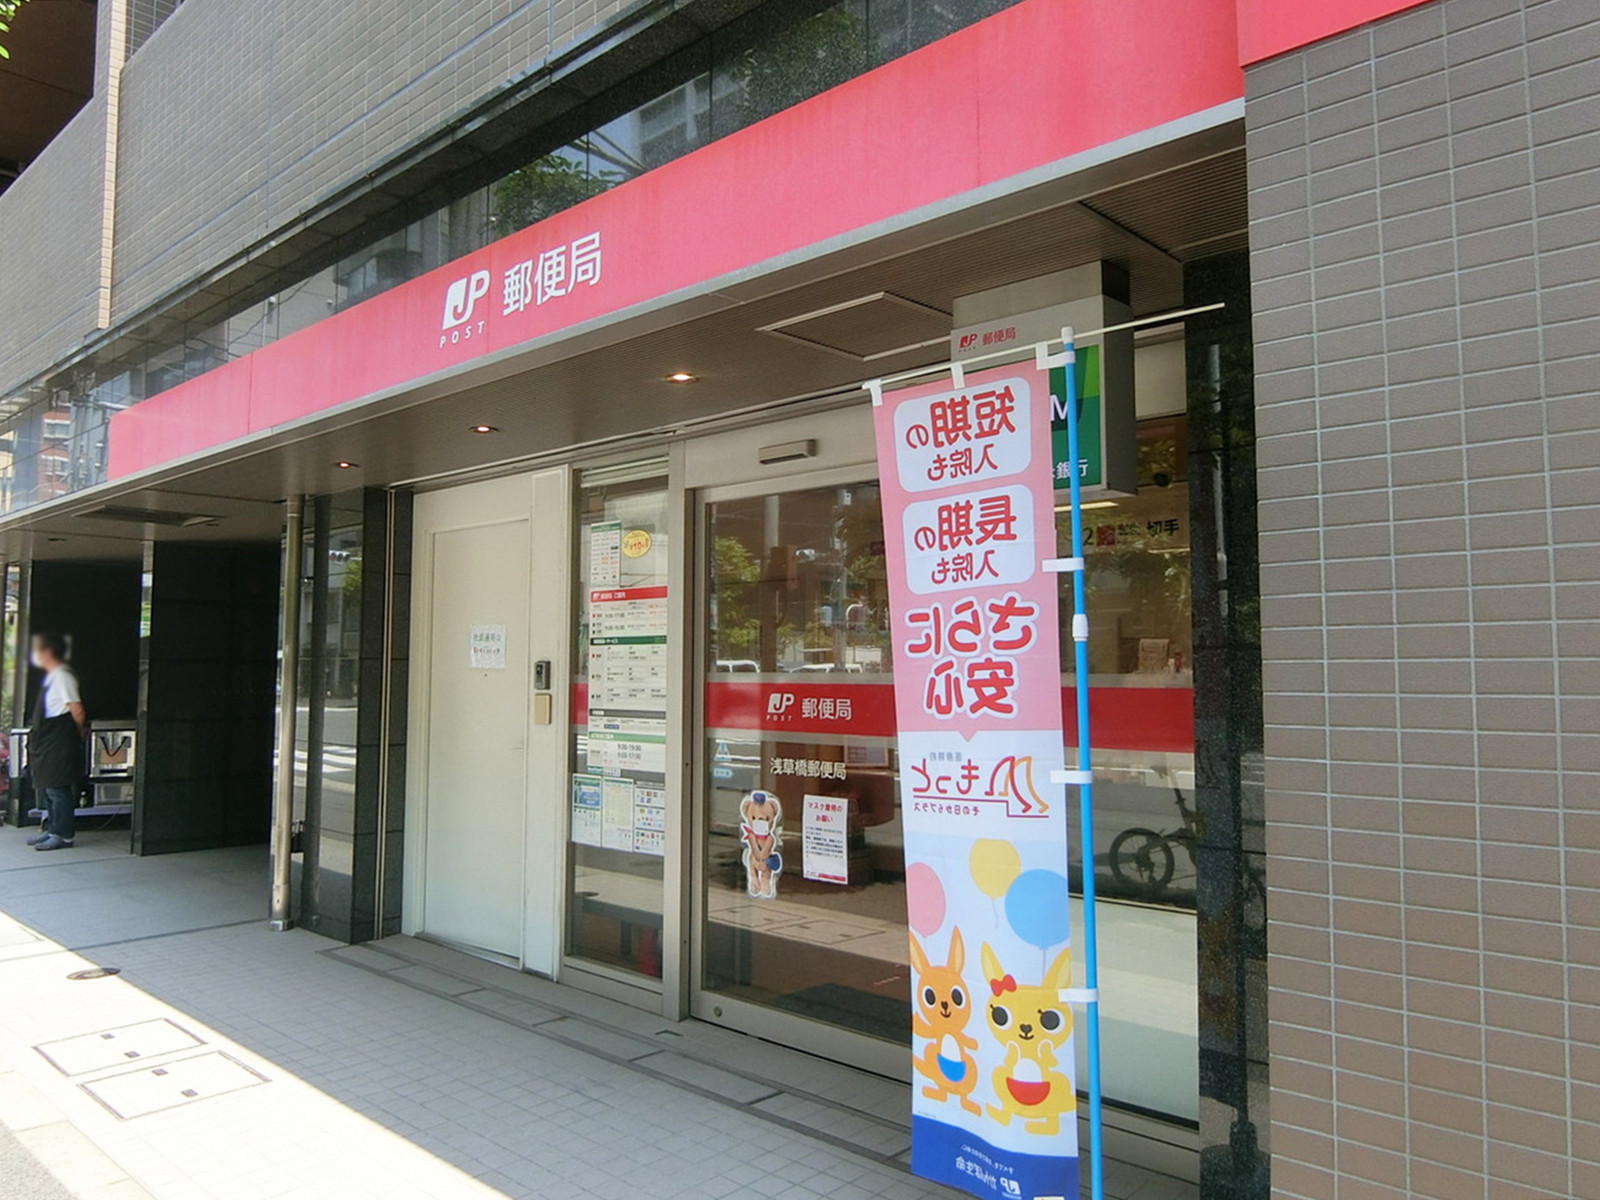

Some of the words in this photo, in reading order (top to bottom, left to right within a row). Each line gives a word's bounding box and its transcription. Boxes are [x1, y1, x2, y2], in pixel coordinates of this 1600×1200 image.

[442, 269, 491, 330] JP
[503, 231, 602, 316] 郵便局
[439, 320, 485, 349] POST
[982, 327, 1017, 346] 郵便局
[1053, 459, 1089, 479] 銀行
[1147, 518, 1179, 537] 切手
[767, 693, 795, 714] JP
[802, 697, 852, 720] 郵便局
[770, 757, 847, 780] 浅草橋郵便局
